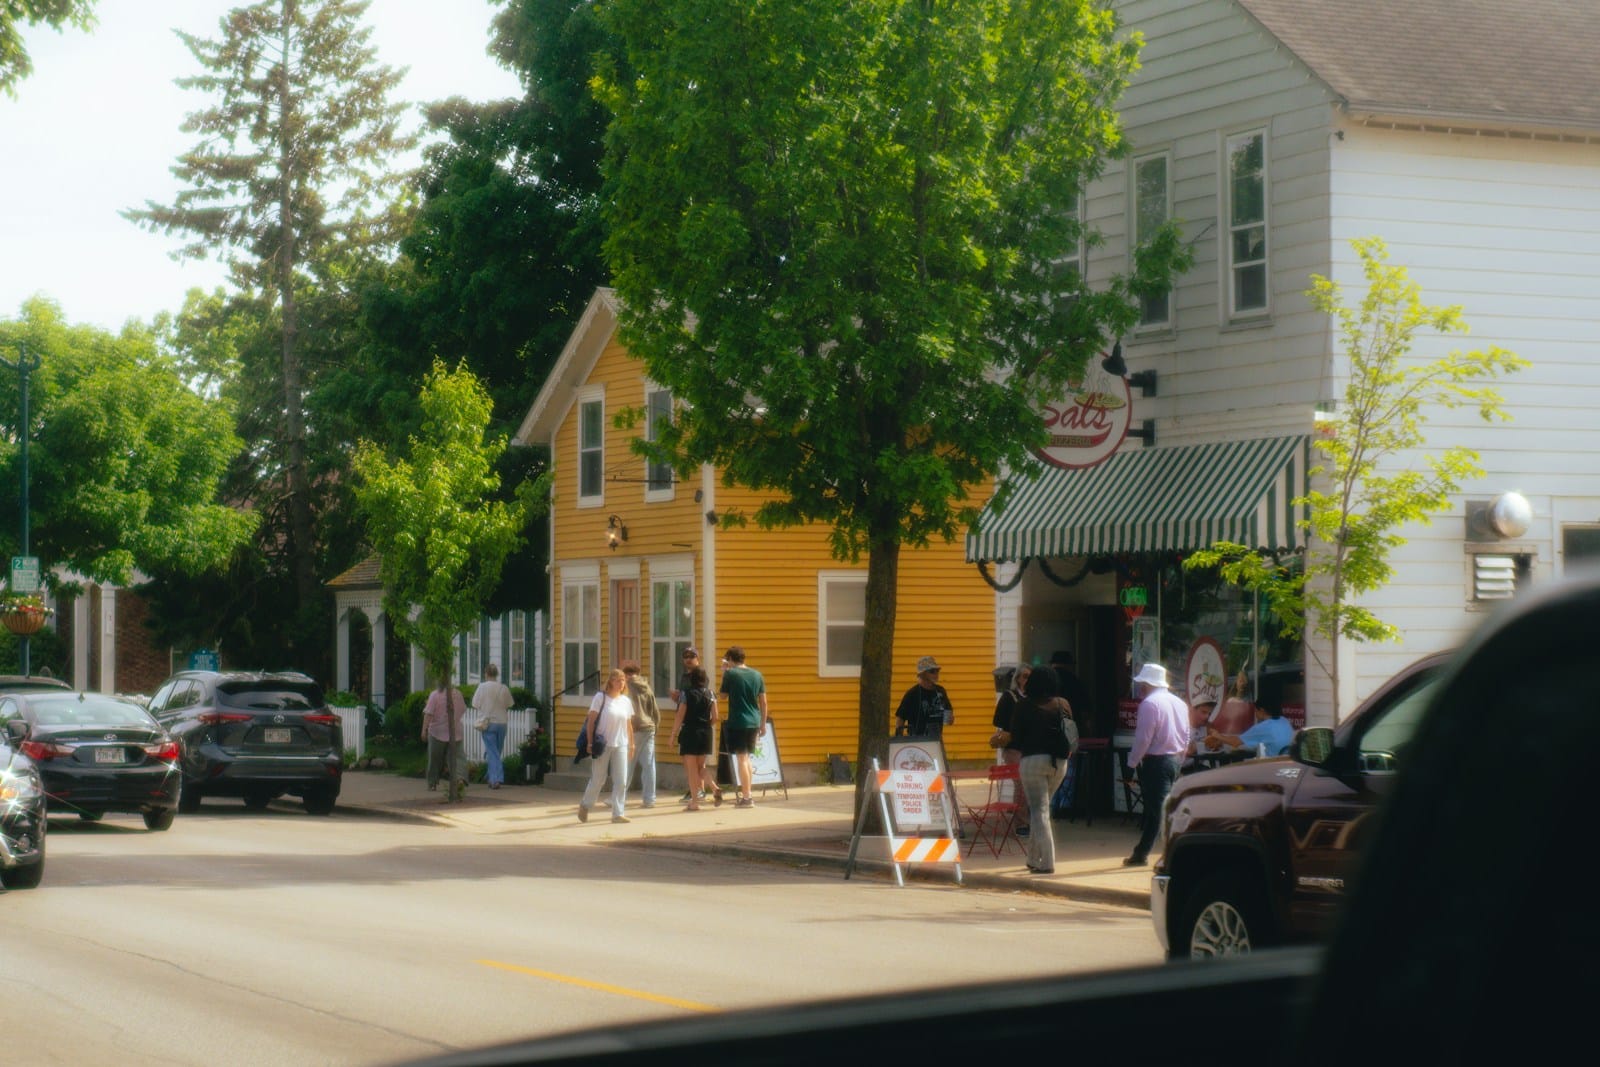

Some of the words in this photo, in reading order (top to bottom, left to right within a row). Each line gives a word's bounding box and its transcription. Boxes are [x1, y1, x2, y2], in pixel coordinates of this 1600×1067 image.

[15, 559, 21, 569] 2
[1119, 586, 1147, 606] OPEN
[903, 774, 913, 782] NO
